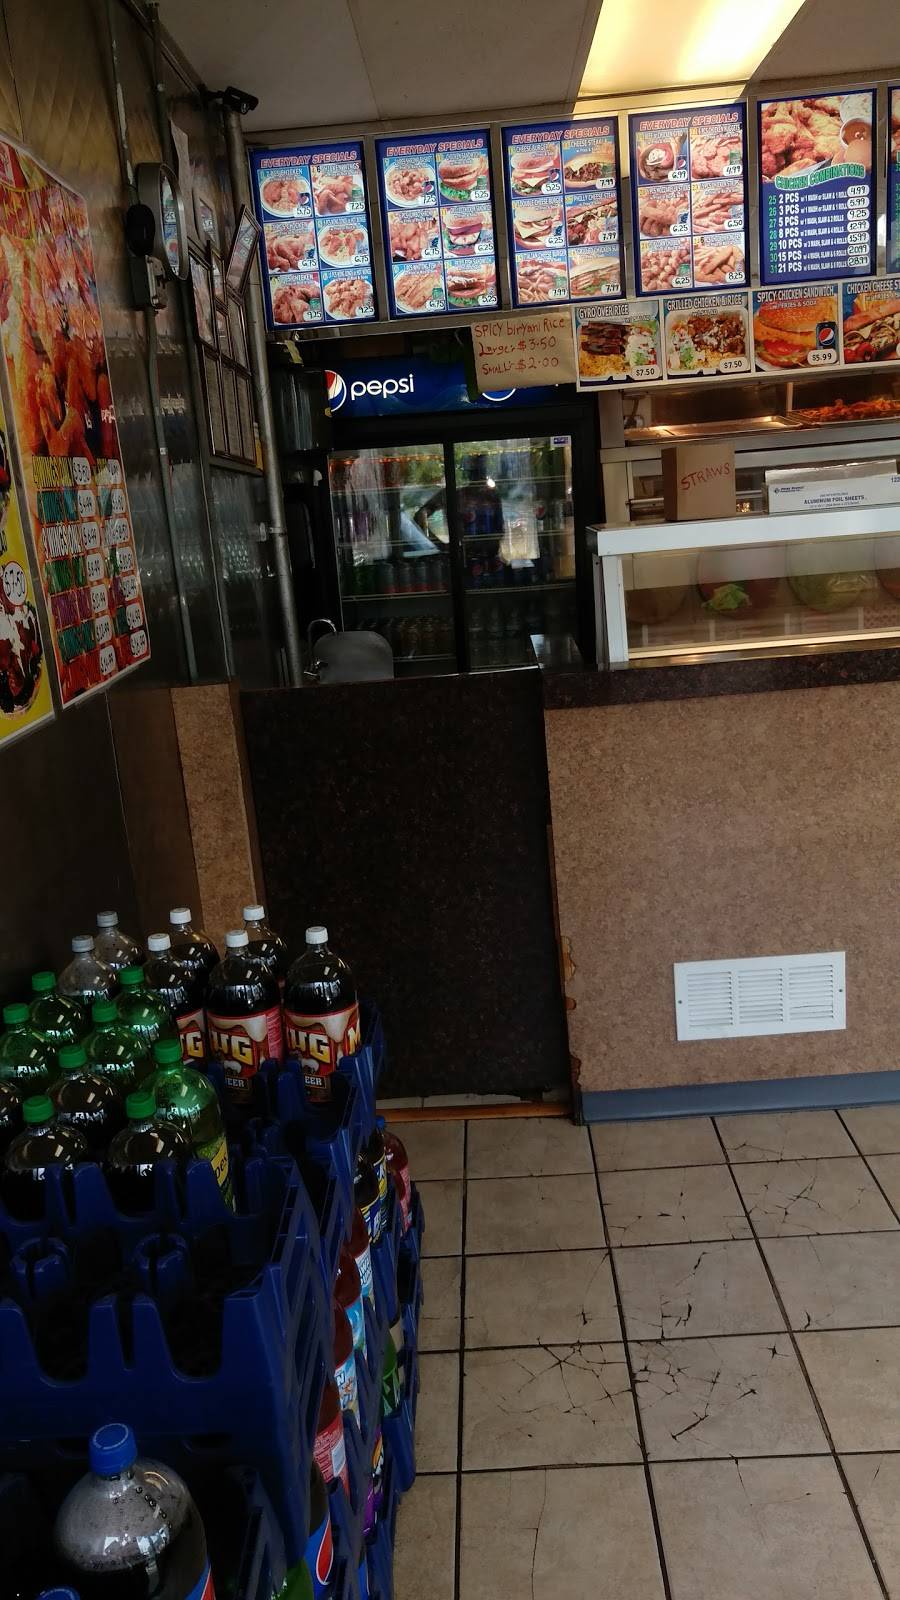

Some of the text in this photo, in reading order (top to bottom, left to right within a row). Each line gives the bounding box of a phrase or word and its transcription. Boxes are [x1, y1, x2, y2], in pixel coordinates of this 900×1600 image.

[640, 112, 738, 130] EVERYDAY SPECIALS
[512, 126, 610, 144] EVERYDAY SPECIALS
[386, 139, 484, 156] EVERYDAY SPECIALS
[261, 151, 357, 168] EVERYDAY SPECIALS
[776, 164, 865, 189] CHICKEN COMBINATIONS
[768, 196, 776, 204] 25
[779, 194, 784, 204] 2
[785, 193, 799, 203] PCS
[769, 208, 776, 216] 26
[779, 206, 784, 215] 3
[785, 204, 799, 214] PCS
[769, 220, 776, 228] 27
[779, 218, 783, 227] 5
[785, 216, 799, 226] PCS
[770, 231, 777, 239] 28
[779, 229, 783, 238] 8
[785, 228, 799, 238] PCS
[770, 242, 777, 250] 29
[778, 240, 786, 250] 10
[788, 239, 802, 249] PCS
[770, 254, 778, 262] 30
[778, 252, 786, 262] 15
[788, 250, 802, 260] PCS
[770, 266, 778, 274] 31
[778, 264, 786, 273] 21
[788, 262, 802, 272] PCS
[757, 286, 834, 303] SPICY CHICKEN SANDWICH
[847, 282, 871, 294] CHICKEN
[873, 280, 893, 291] CHEESE
[667, 299, 692, 311] GRILLED
[693, 296, 720, 308] CHICKEN
[727, 294, 743, 305] RICE
[579, 304, 629, 319] GYRO OVER RICE
[474, 322, 503, 338] SPICY
[636, 368, 655, 376] $7.50
[351, 374, 415, 401] pepsi
[681, 463, 731, 491] STRAWS
[305, 1076, 322, 1086] EER
